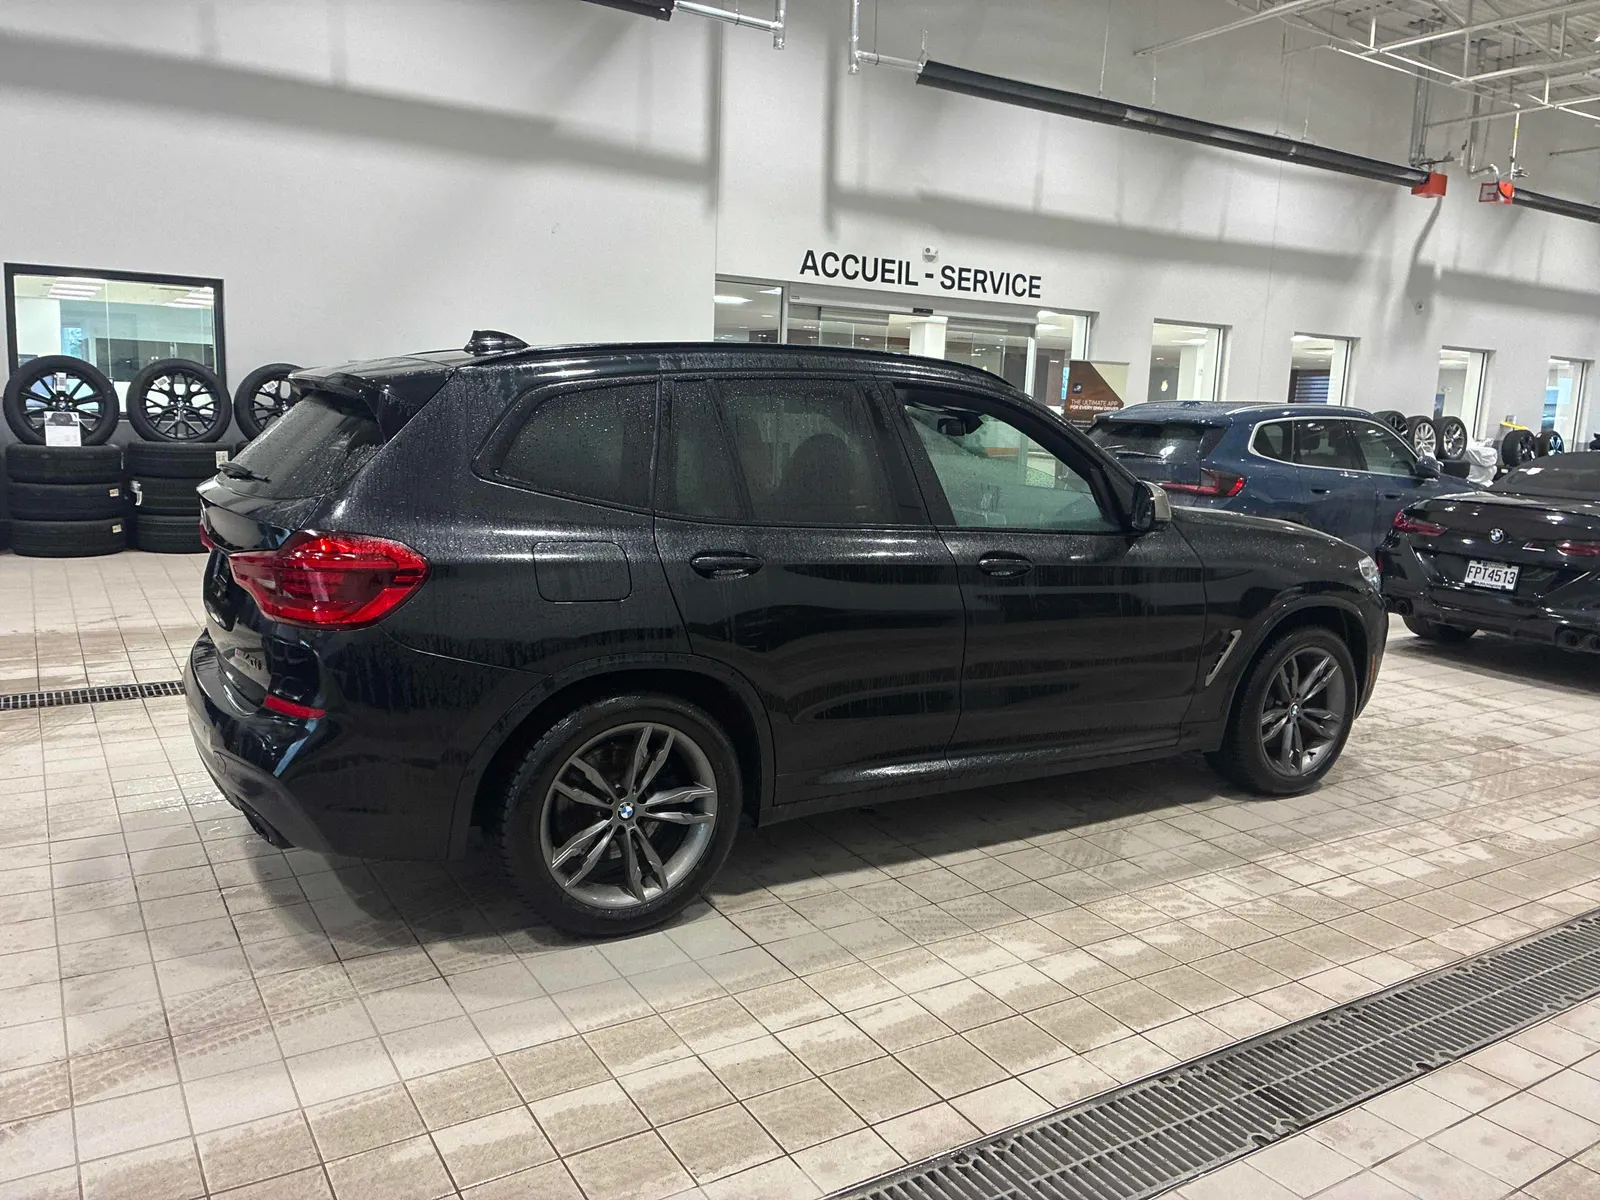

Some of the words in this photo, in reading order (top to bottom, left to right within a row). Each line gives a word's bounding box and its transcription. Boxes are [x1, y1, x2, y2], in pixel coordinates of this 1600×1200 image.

[799, 249, 919, 287] ACCUEIL
[940, 265, 1042, 299] SERVICE
[1466, 565, 1516, 585] FPT4513
